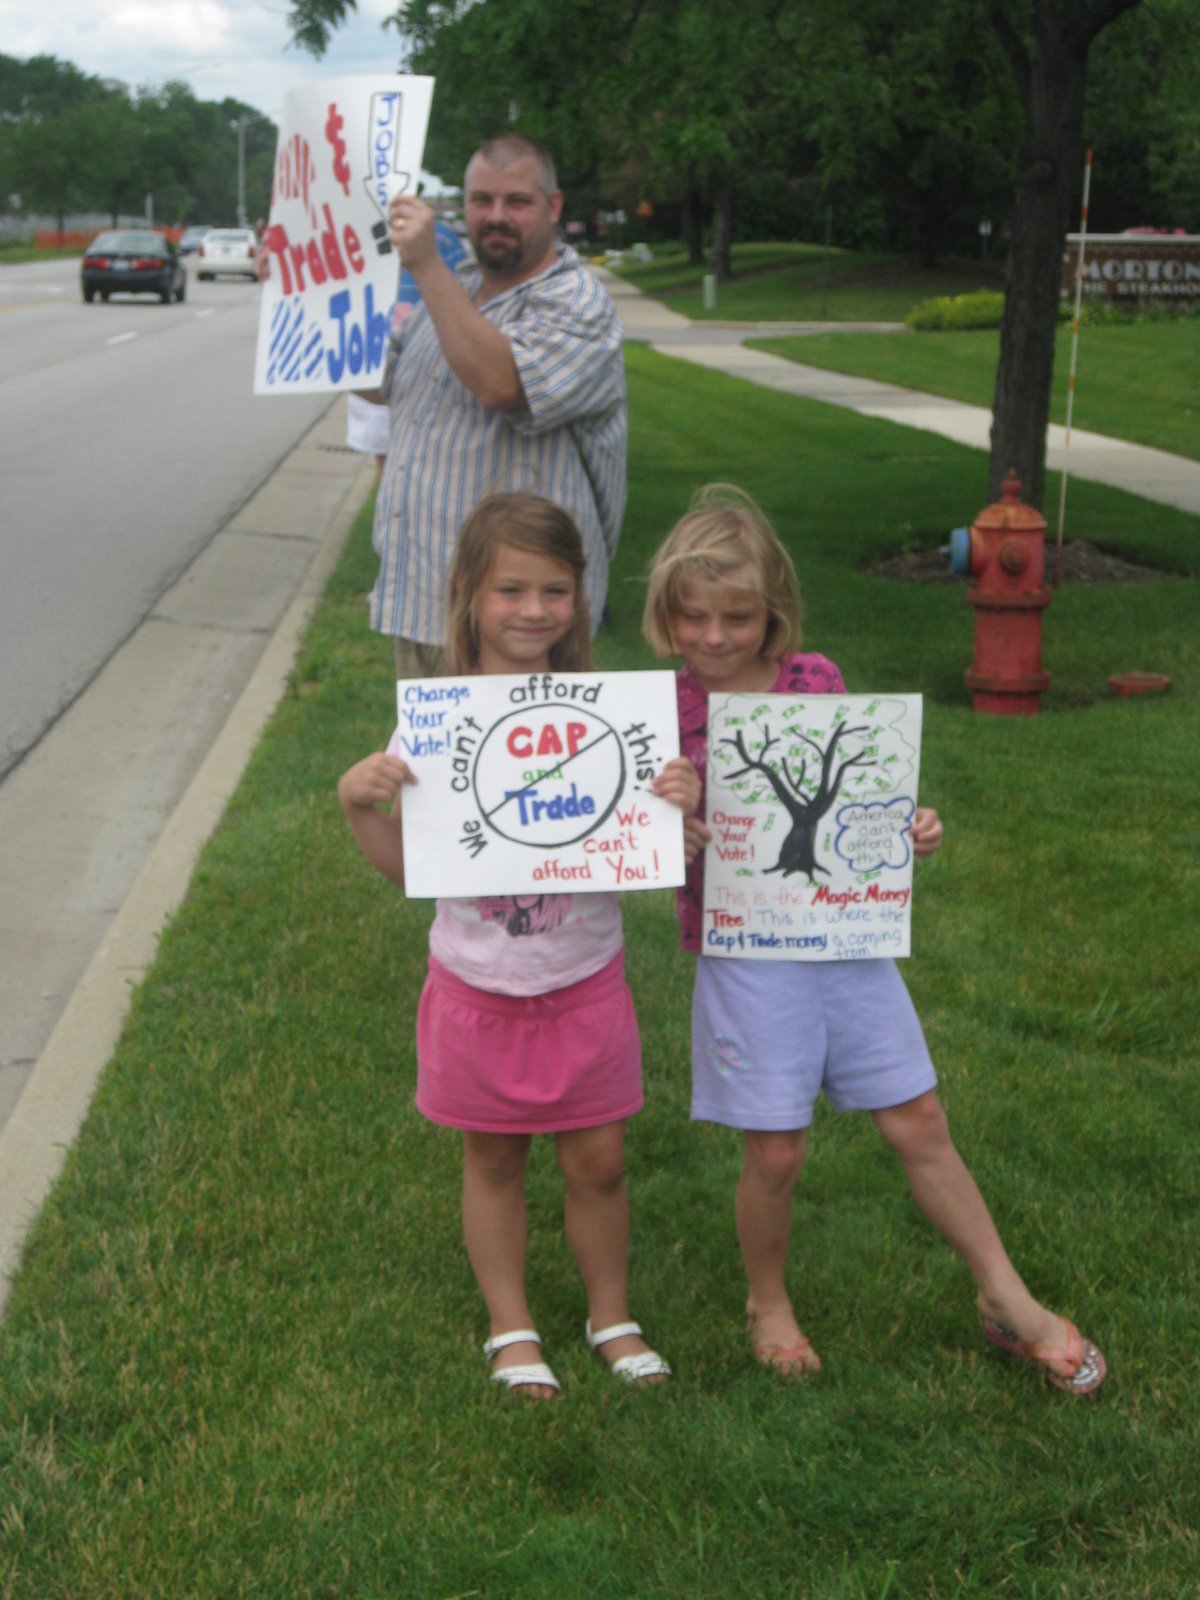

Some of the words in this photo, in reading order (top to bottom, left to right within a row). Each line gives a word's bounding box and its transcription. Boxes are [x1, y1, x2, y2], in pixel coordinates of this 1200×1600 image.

[375, 93, 399, 206] JOBS
[267, 203, 365, 296] Trade
[404, 684, 471, 707] Change
[509, 675, 603, 704] afford
[402, 707, 447, 729] Your
[401, 730, 452, 757] Vote!
[506, 722, 587, 758] CAP
[450, 715, 483, 793] can't
[522, 762, 564, 782] and
[504, 783, 596, 826] Trade
[615, 804, 650, 827] We
[847, 809, 904, 823] America
[712, 811, 757, 830] Change
[459, 819, 488, 859] We
[582, 832, 637, 853] can't
[718, 826, 748, 843] Your
[847, 836, 893, 851] afford
[715, 844, 755, 863] Vote!
[532, 859, 592, 882] afford
[714, 886, 746, 907] This
[753, 888, 768, 907] is
[772, 886, 804, 906] the
[811, 884, 863, 911] Magic
[863, 883, 911, 909] Money
[756, 909, 794, 926] This
[803, 911, 817, 925] is
[826, 907, 872, 924] where
[879, 907, 905, 924] the
[707, 929, 735, 953] Cap
[747, 931, 783, 949] Trade
[785, 933, 828, 953] money
[847, 930, 902, 949] coming
[833, 944, 872, 961] from
